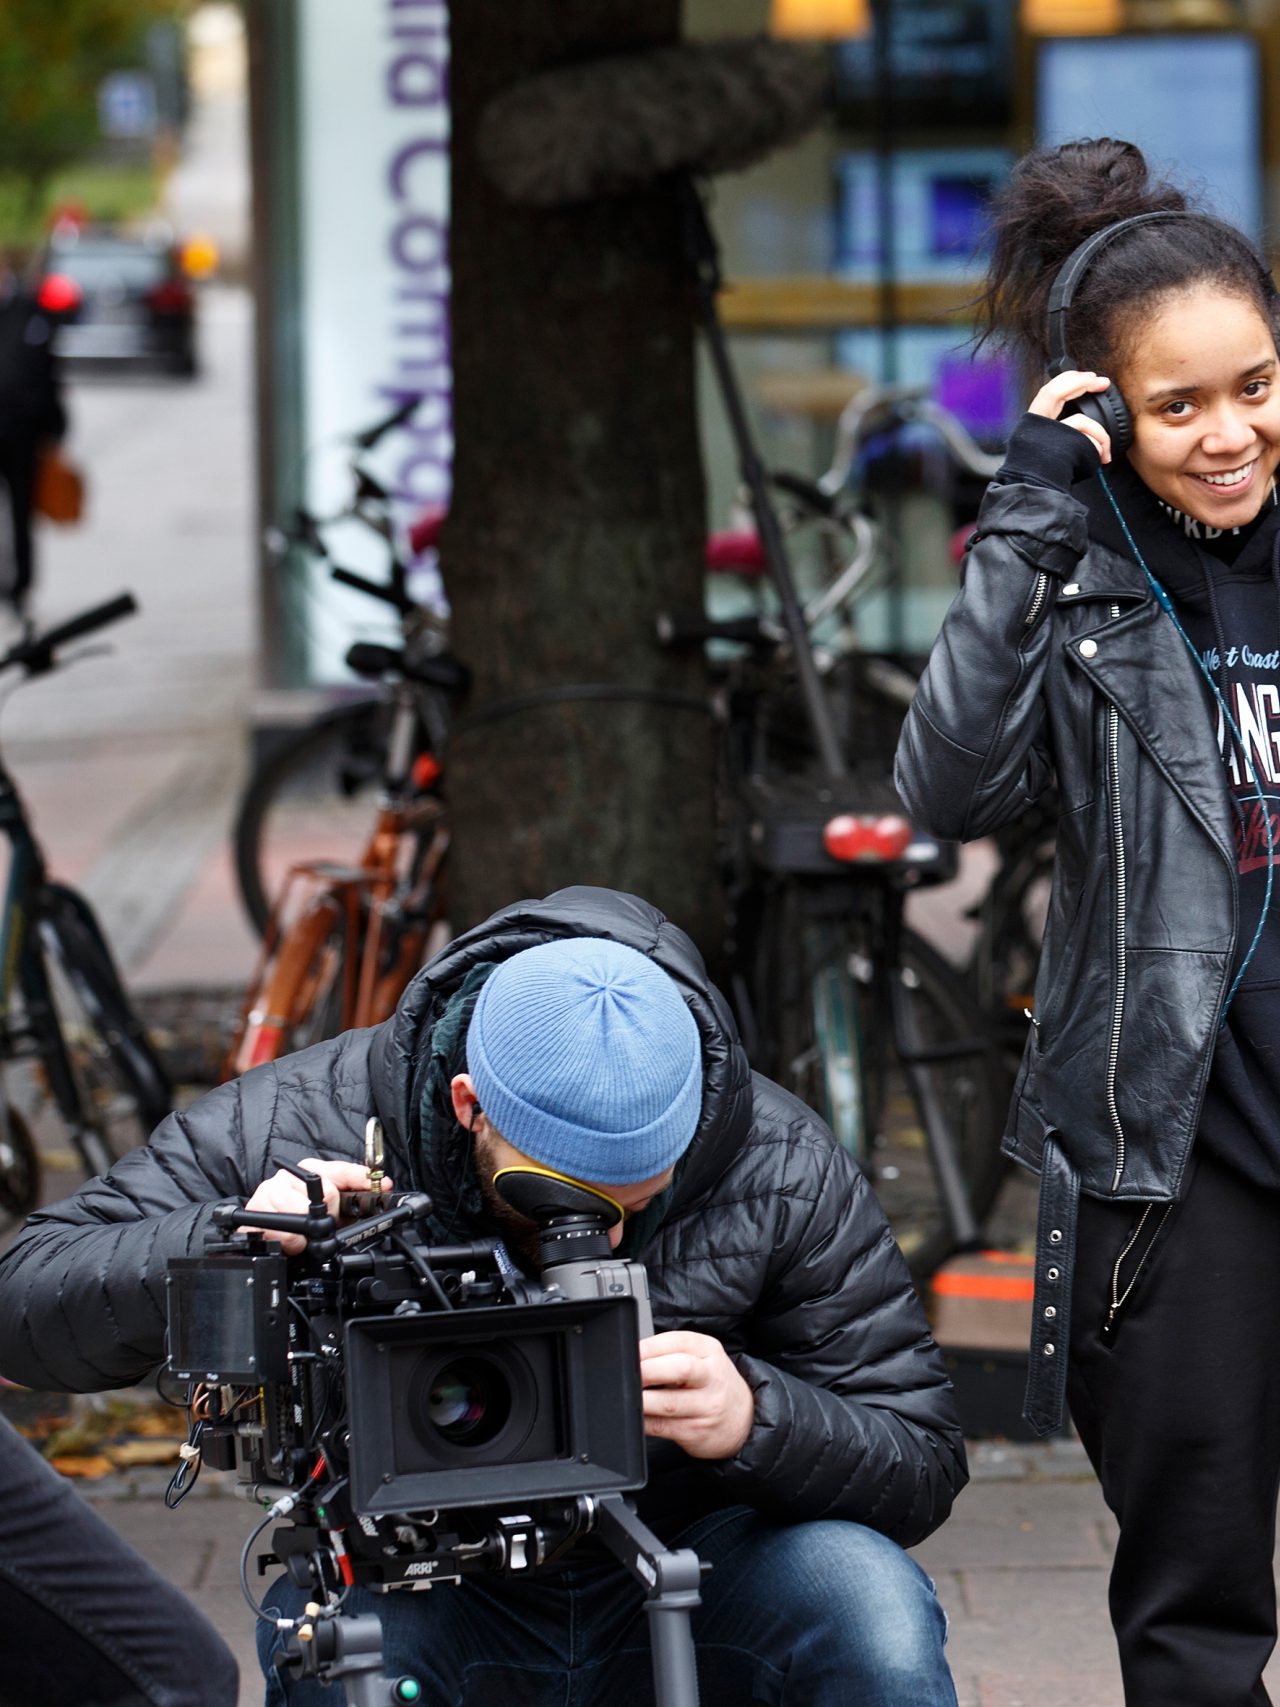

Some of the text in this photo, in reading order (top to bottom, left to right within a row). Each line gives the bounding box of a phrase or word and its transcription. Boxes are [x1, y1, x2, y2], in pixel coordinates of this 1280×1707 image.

[1203, 644, 1280, 671] Wet Coast
[404, 1561, 433, 1577] ARRI
